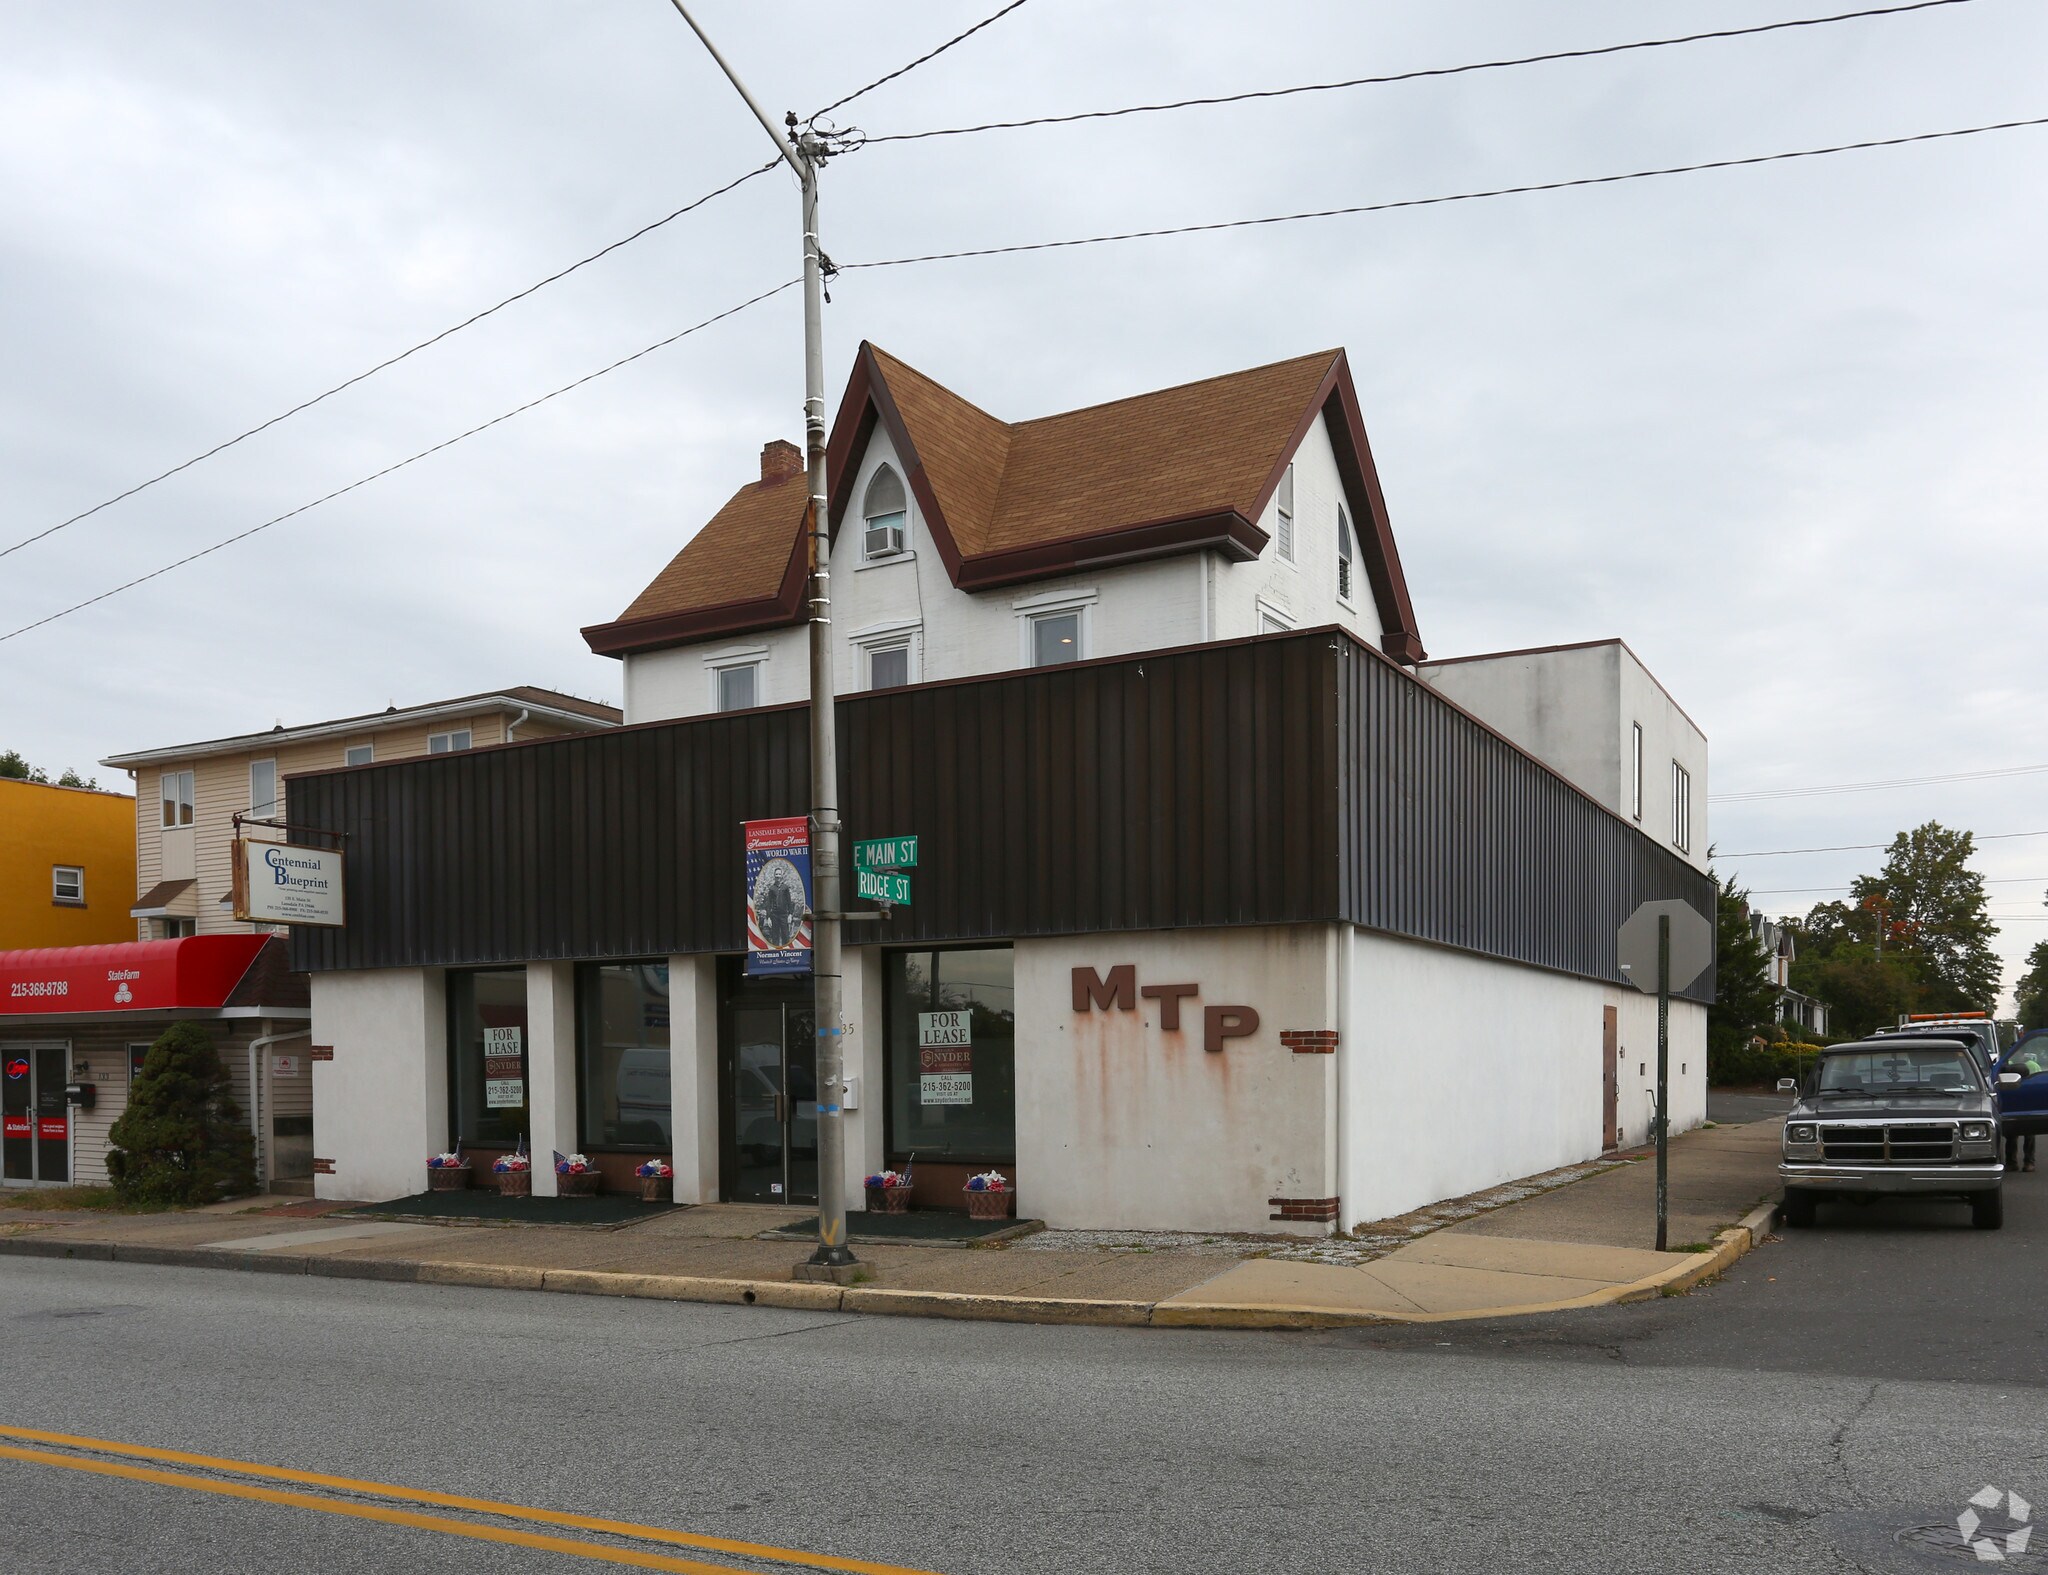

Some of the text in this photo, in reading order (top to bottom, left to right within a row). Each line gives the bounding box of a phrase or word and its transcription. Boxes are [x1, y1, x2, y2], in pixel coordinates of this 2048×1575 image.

[748, 826, 805, 837] LANSDALE BOROUGH
[747, 836, 806, 849] Hometown Heroes
[264, 848, 321, 870] Centennial
[765, 847, 808, 858] WORLD WAR II
[854, 840, 916, 867] E MAIN ST
[274, 866, 328, 889] Blueprint
[860, 871, 909, 900] RIDGE ST
[756, 950, 803, 959] Norman Vincent
[11, 981, 68, 997] 215-368-8788
[1071, 964, 1260, 1052] MTP
[930, 1013, 960, 1028] FOR
[493, 1028, 513, 1041] FOR
[924, 1029, 967, 1044] LEASE
[488, 1042, 519, 1055] LEASE
[923, 1081, 971, 1092] 215-362-5200
